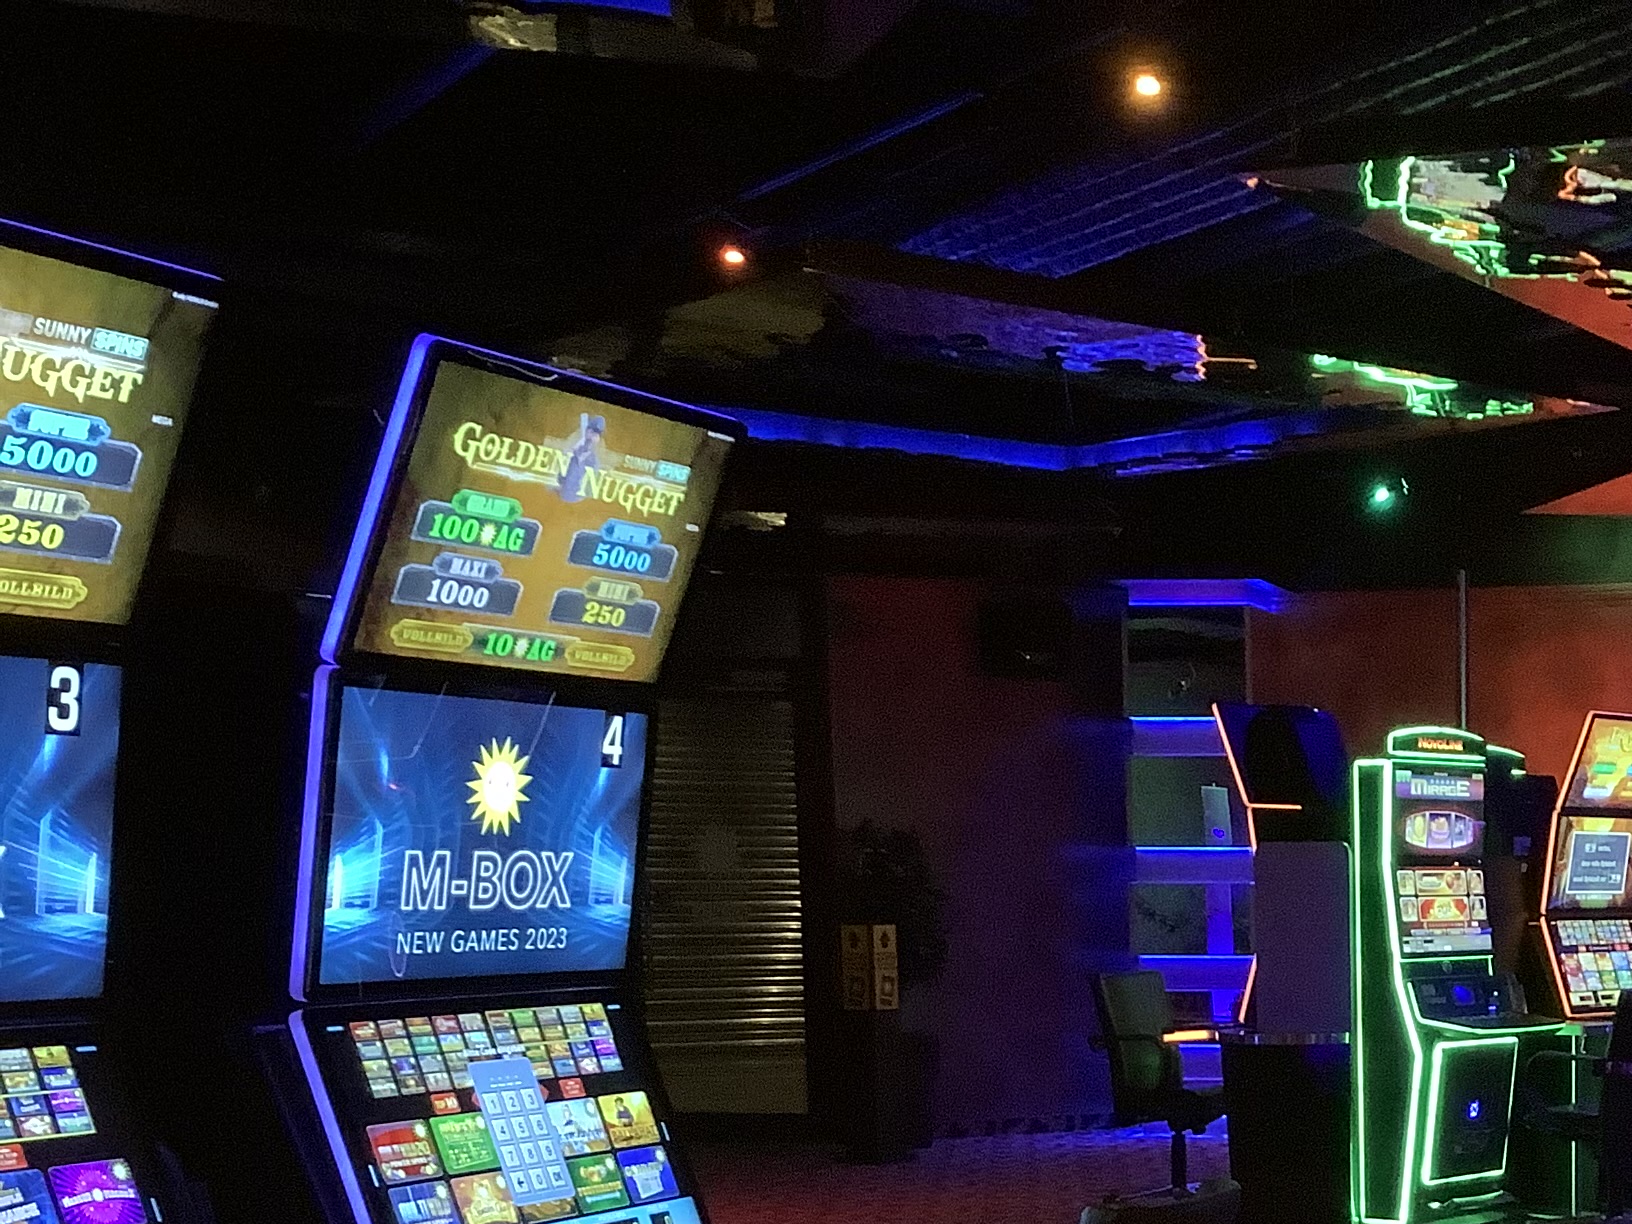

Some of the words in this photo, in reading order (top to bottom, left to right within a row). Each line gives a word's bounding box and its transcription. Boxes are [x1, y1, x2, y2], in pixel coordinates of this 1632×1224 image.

[33, 317, 92, 345] SUNNY
[94, 331, 145, 358] SPINS
[0, 338, 144, 403] UGGET
[0, 436, 98, 477] 5000
[453, 422, 575, 478] GOLDEN
[623, 454, 657, 473] SUNNY
[577, 465, 686, 517] NUGGET
[0, 514, 65, 549] 250
[428, 513, 480, 544] 100
[493, 522, 526, 552] AG
[449, 558, 488, 579] MAXI
[593, 543, 652, 572] 5000
[0, 580, 73, 599] OLLBILD
[426, 579, 490, 608] 1000
[583, 601, 626, 627] 250
[484, 632, 514, 656] 10
[527, 638, 557, 662] AG
[47, 666, 81, 733] 3
[602, 715, 624, 766] 4
[1411, 778, 1470, 797] MIRAGE
[401, 850, 574, 910] M-BOX
[396, 931, 445, 955] NEW
[451, 929, 518, 952] GAMES
[525, 927, 568, 950] 2023
